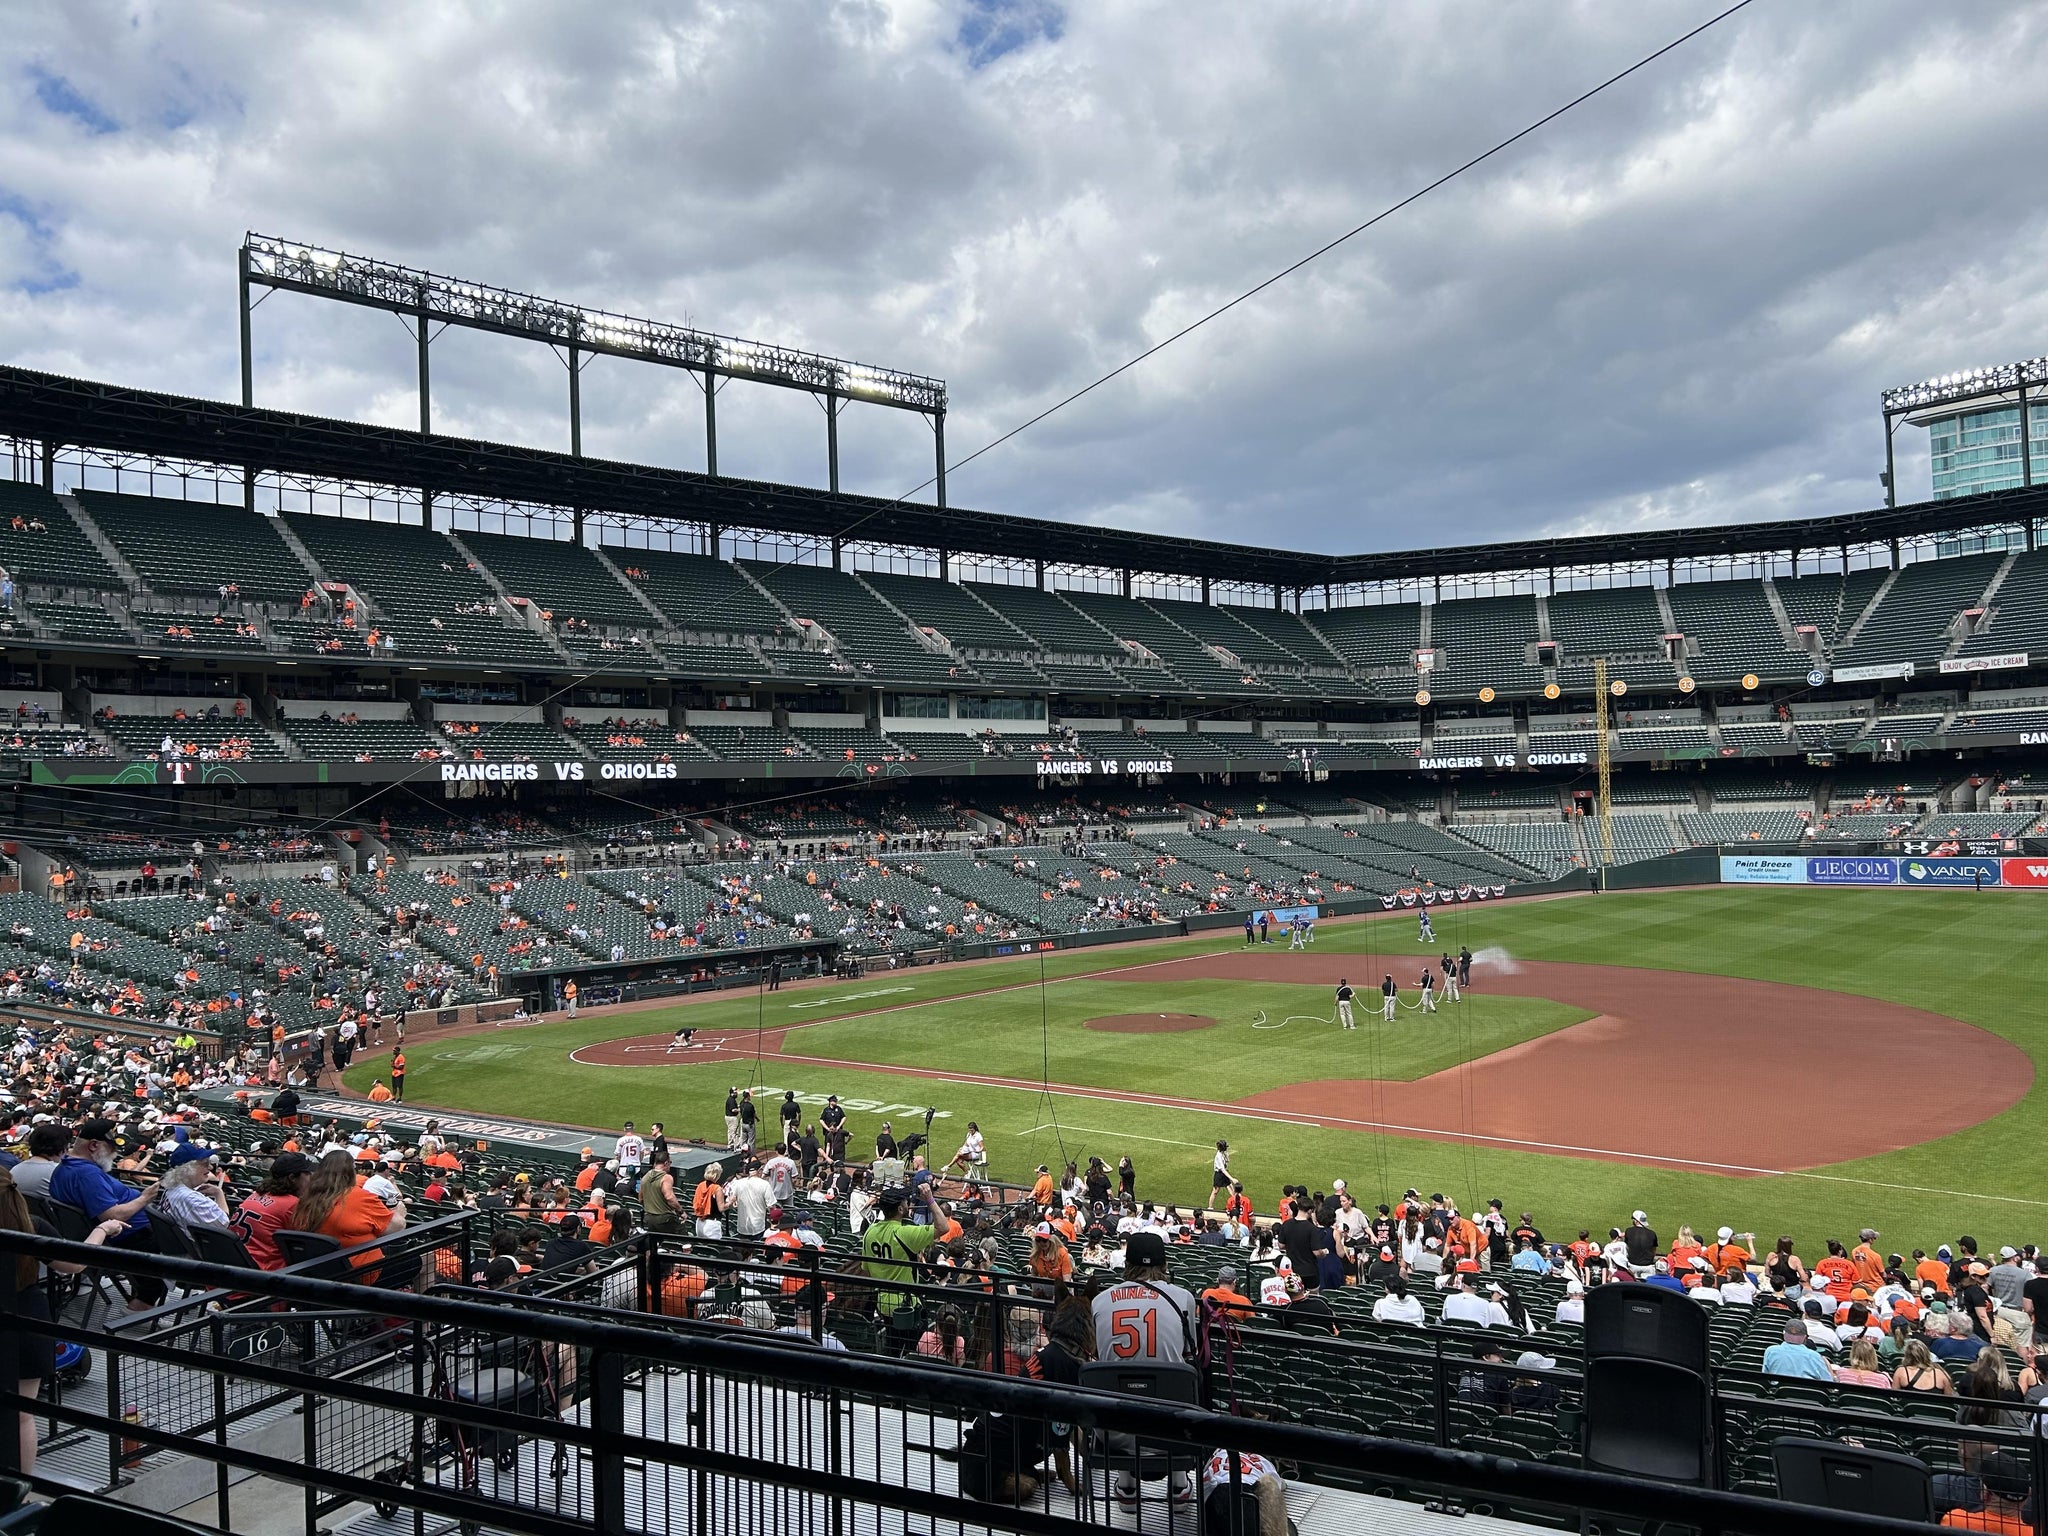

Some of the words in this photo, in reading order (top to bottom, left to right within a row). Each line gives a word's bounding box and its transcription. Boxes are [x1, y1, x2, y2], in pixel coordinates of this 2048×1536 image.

[1944, 662, 1962, 670] ENJOY
[1991, 658, 2000, 666] ICE
[2004, 656, 2024, 666] CREAM
[1748, 678, 1753, 686] 8
[1809, 674, 1822, 682] 42
[1613, 684, 1624, 692] 22
[1682, 680, 1693, 689] 33
[1484, 690, 1490, 698] 5
[1549, 688, 1555, 696] 4
[1418, 694, 1429, 702] 20
[1419, 757, 1483, 770] RANGERS
[1493, 754, 1516, 767] VS
[1527, 752, 1588, 766] ORIOLES
[441, 763, 539, 782] RANGERS
[554, 762, 584, 780] VS
[600, 763, 678, 779] ORIOLES
[1036, 760, 1092, 774] RANGERS
[1100, 760, 1118, 774] VS
[1127, 760, 1173, 773] ORIOLES
[1735, 860, 1758, 868] Point
[1760, 860, 1792, 868] Breeze
[1814, 862, 1890, 876] LECOM
[1927, 866, 1992, 877] VANDA
[996, 946, 1013, 954] TEX
[1020, 944, 1032, 952] VS
[444, 1121, 557, 1141] ORIOLES
[626, 1146, 637, 1157] 15
[871, 1241, 892, 1259] 90
[1824, 1260, 1848, 1270] ROBINSON
[1832, 1270, 1842, 1283] 5
[1110, 1286, 1160, 1302] HINES
[1112, 1308, 1157, 1358] 51
[248, 1332, 268, 1356] 16
